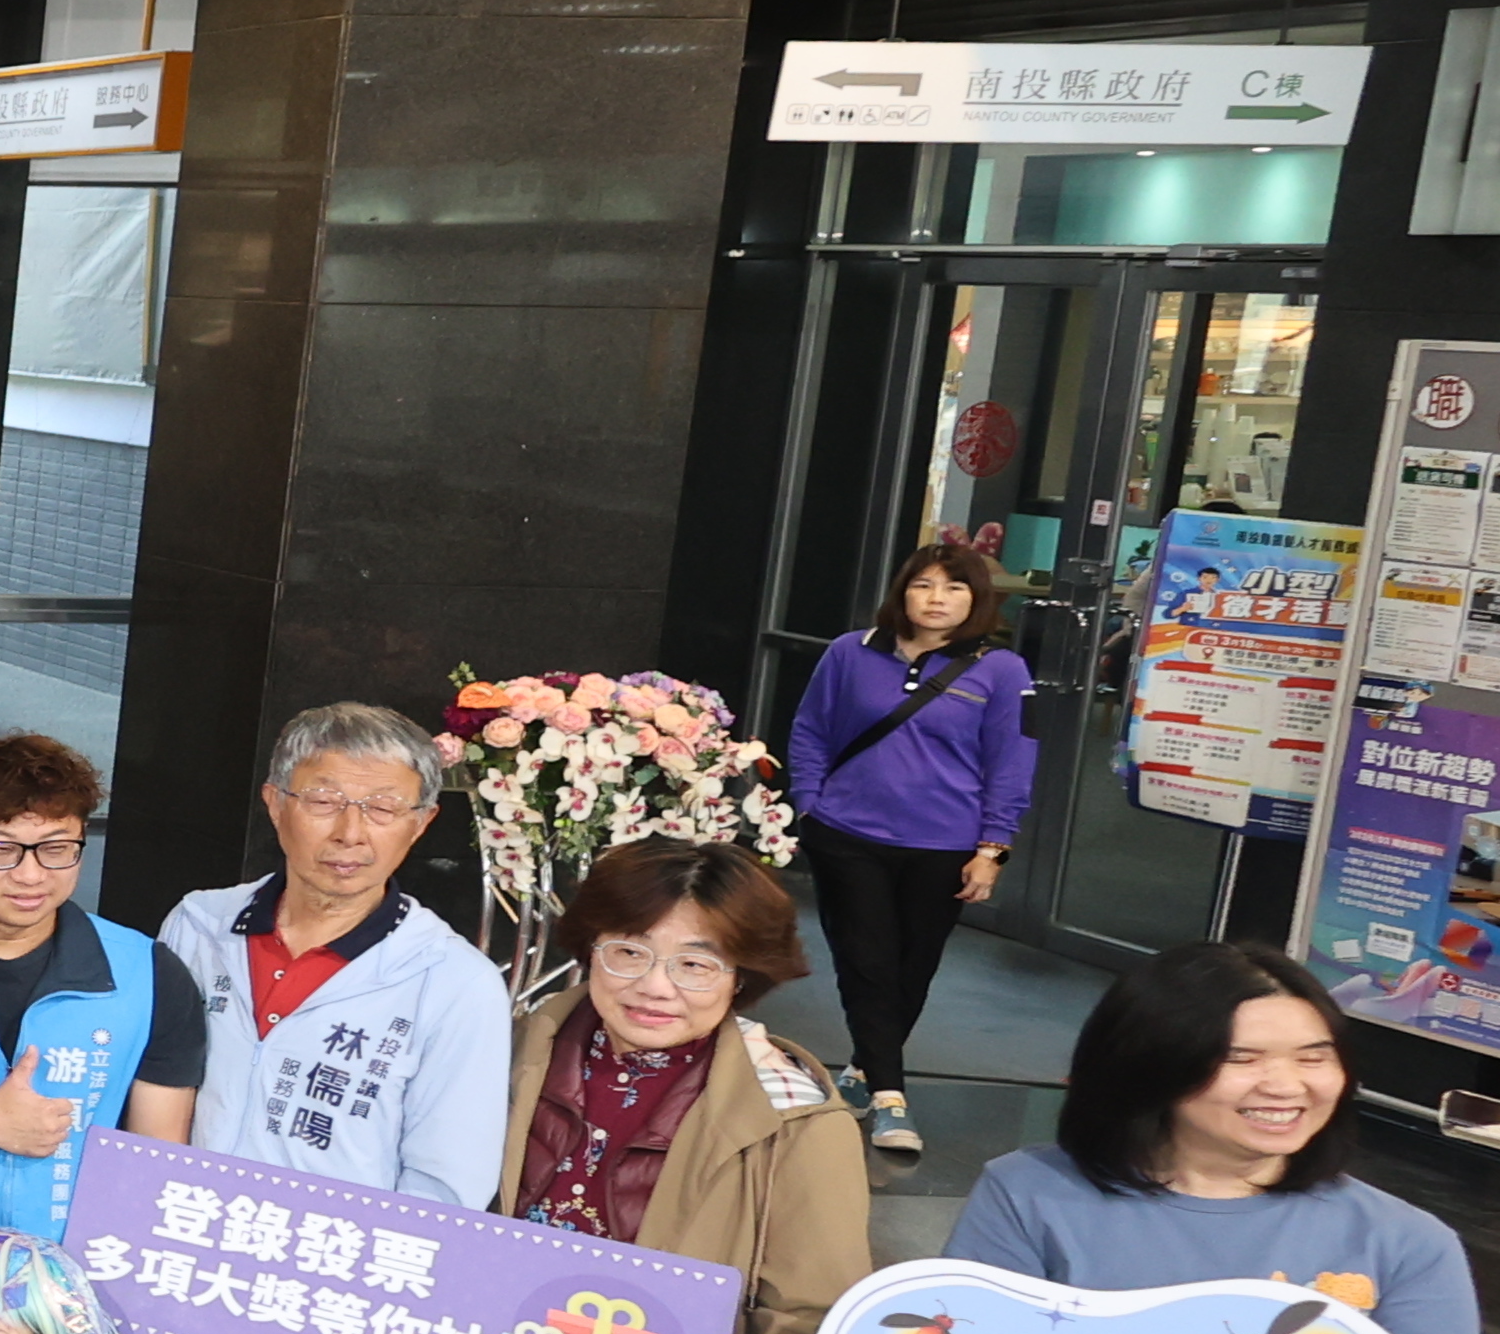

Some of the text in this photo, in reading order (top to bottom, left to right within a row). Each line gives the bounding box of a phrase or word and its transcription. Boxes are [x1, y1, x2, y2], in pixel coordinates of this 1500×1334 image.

[95, 83, 150, 107] 服務中心
[965, 67, 1192, 102] 南投縣政府
[963, 110, 1175, 124] NANTOU COUNTY GOVERNMENT
[1243, 567, 1336, 599] 小型
[1360, 739, 1497, 786] 對位新趨勢
[348, 1016, 413, 1120] 南投縣議員
[266, 1057, 302, 1136] 服務團隊
[151, 1177, 442, 1302] 登錄發票
